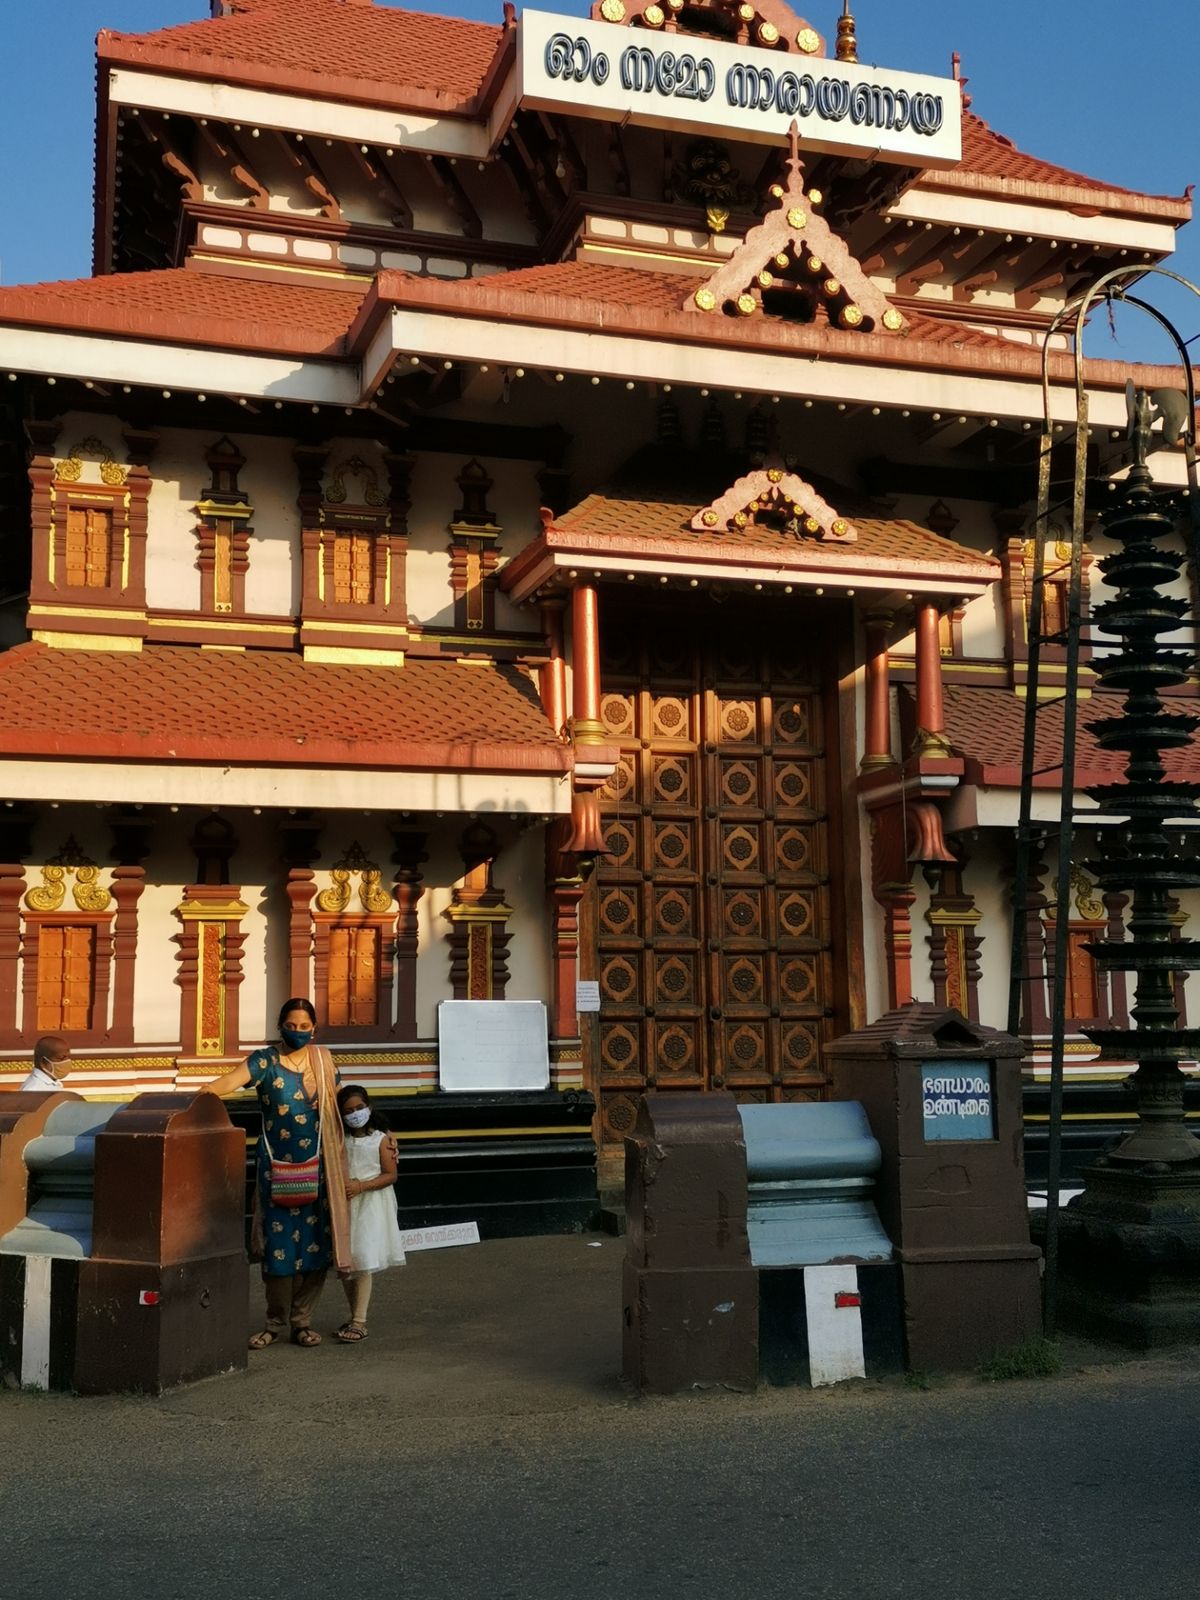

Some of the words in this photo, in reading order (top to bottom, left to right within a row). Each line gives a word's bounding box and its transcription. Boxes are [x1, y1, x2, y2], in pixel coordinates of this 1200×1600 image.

[545, 32, 610, 85] ഓം
[619, 45, 717, 101] നമോ
[726, 62, 944, 136] നാരായണായ
[922, 1077, 991, 1094] ഭണ്ഡാരം
[923, 1094, 990, 1119] உண்டிகை
